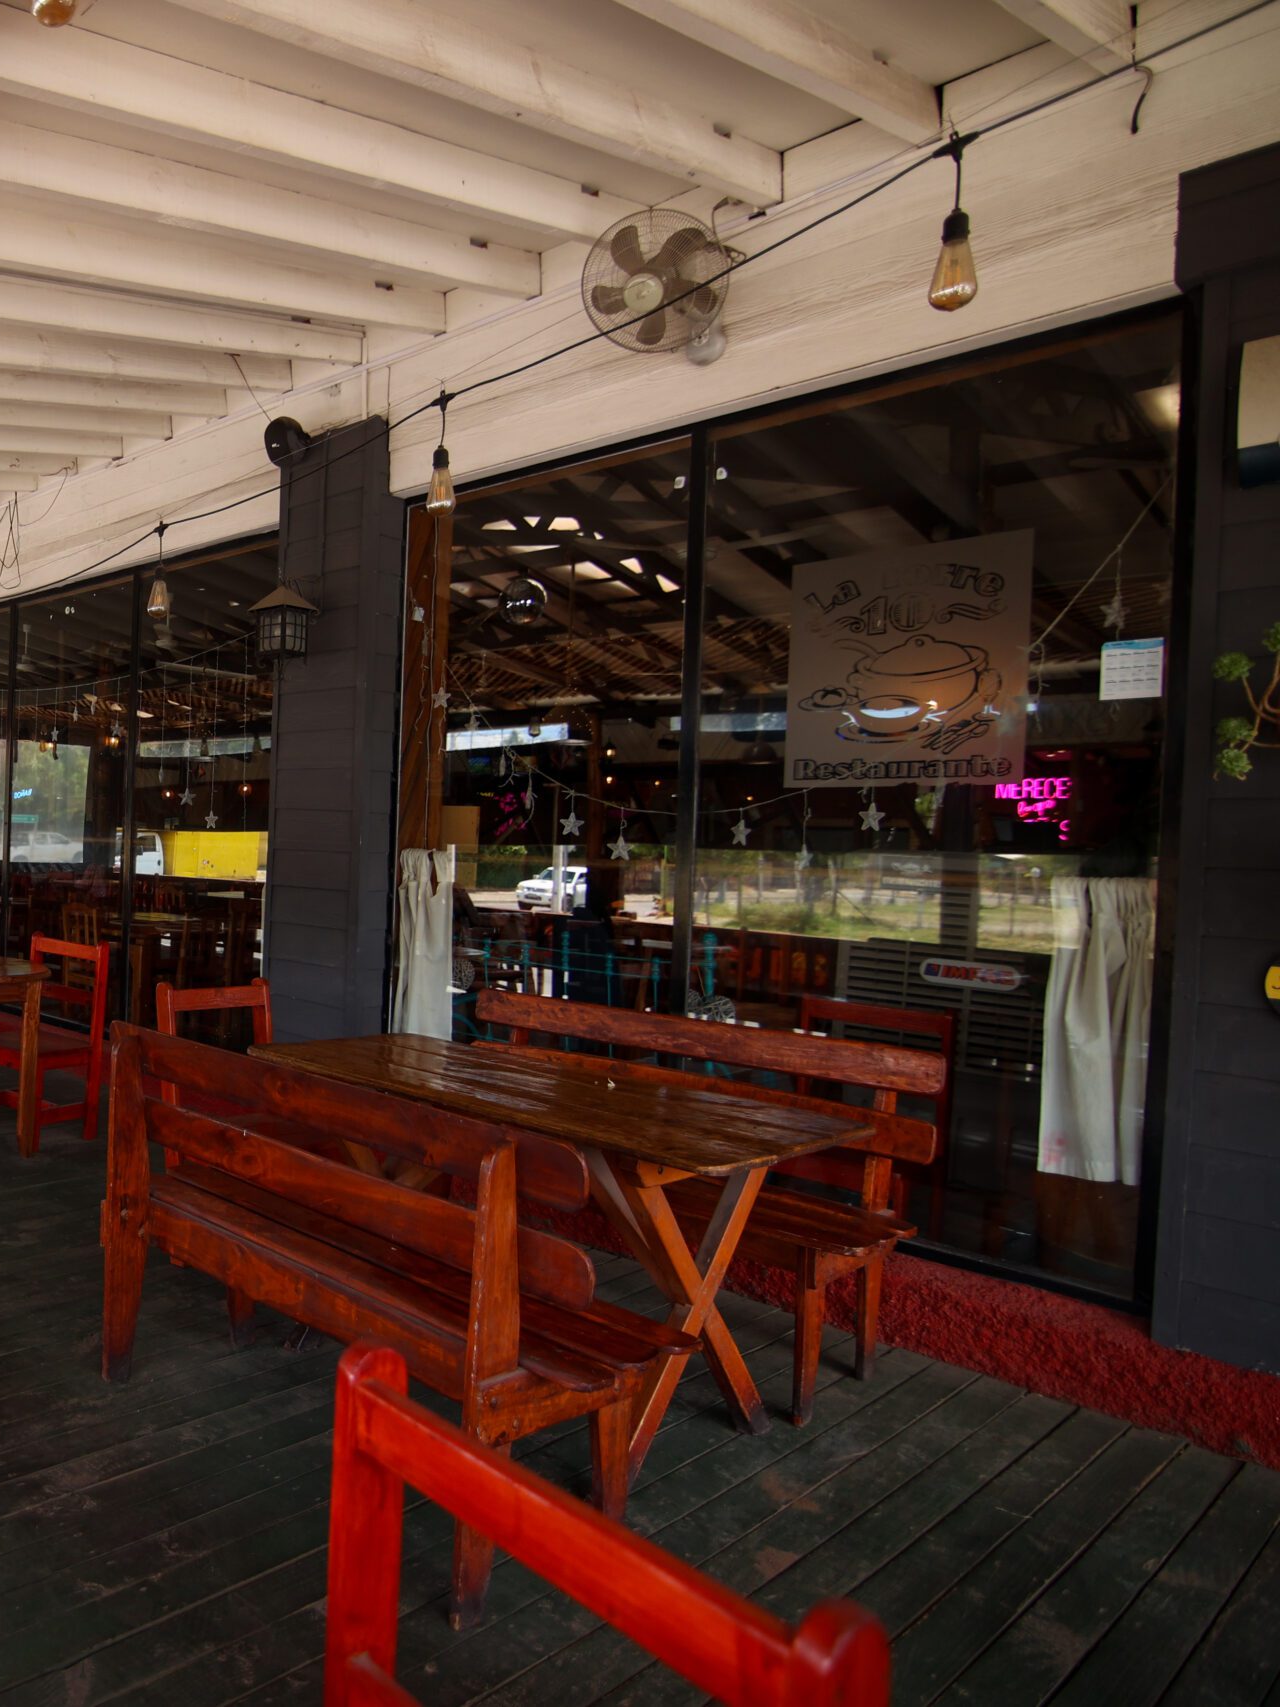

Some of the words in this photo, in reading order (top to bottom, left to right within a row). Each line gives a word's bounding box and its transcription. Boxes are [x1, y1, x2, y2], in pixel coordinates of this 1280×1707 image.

[804, 580, 861, 615] La
[861, 592, 934, 635] 10
[793, 755, 1012, 781] Restaurante
